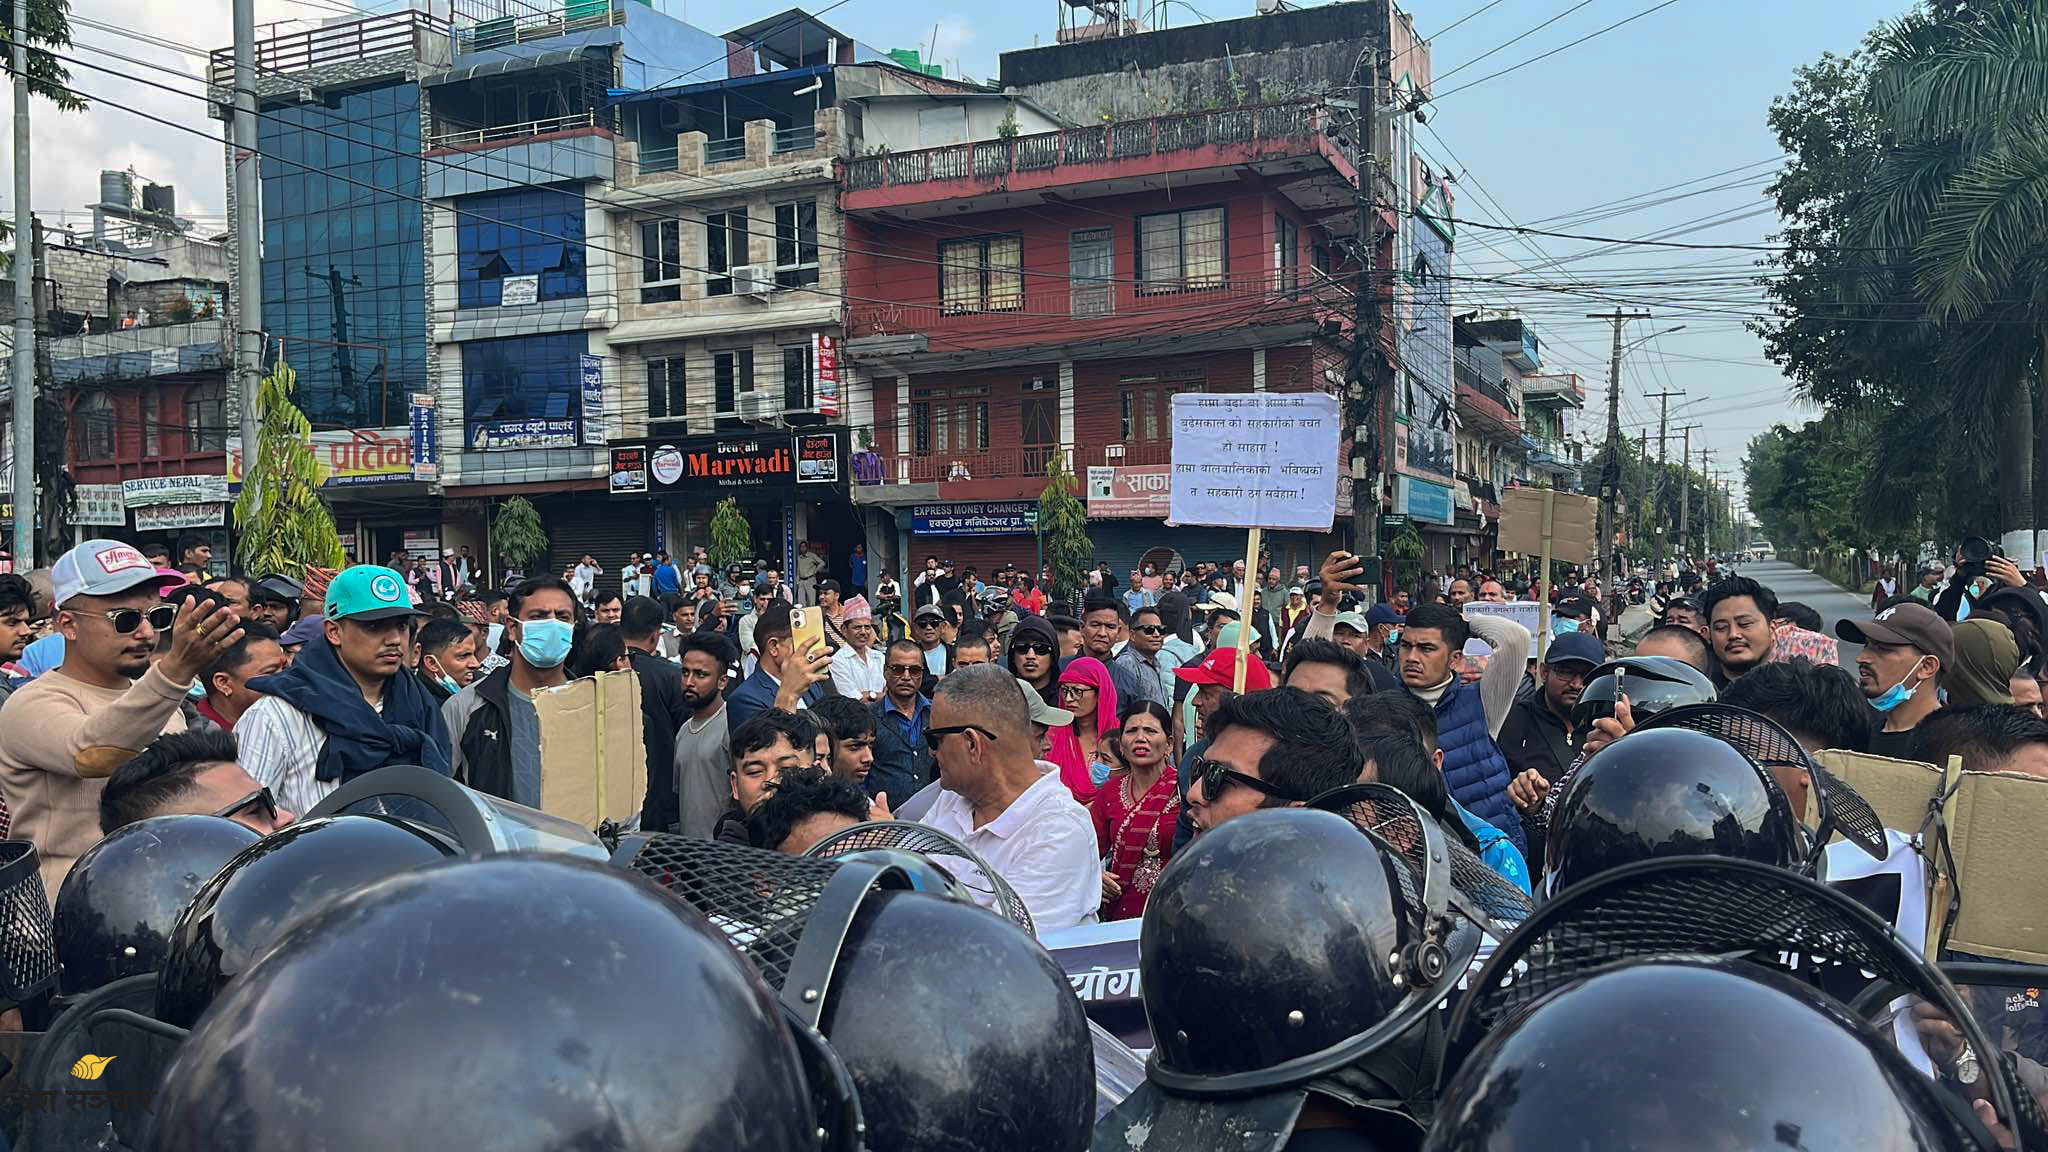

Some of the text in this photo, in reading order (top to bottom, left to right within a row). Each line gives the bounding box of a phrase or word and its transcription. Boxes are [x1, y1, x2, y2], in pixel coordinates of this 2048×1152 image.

[688, 448, 790, 477] Marwadi
[124, 479, 167, 492] SERVICE
[169, 476, 201, 488] NEPAL
[1127, 473, 1170, 492] साका
[914, 503, 1029, 516] EXPRESS MONEY CHANGER
[1066, 965, 1140, 1000] योग
[2005, 993, 2025, 1003] ack
